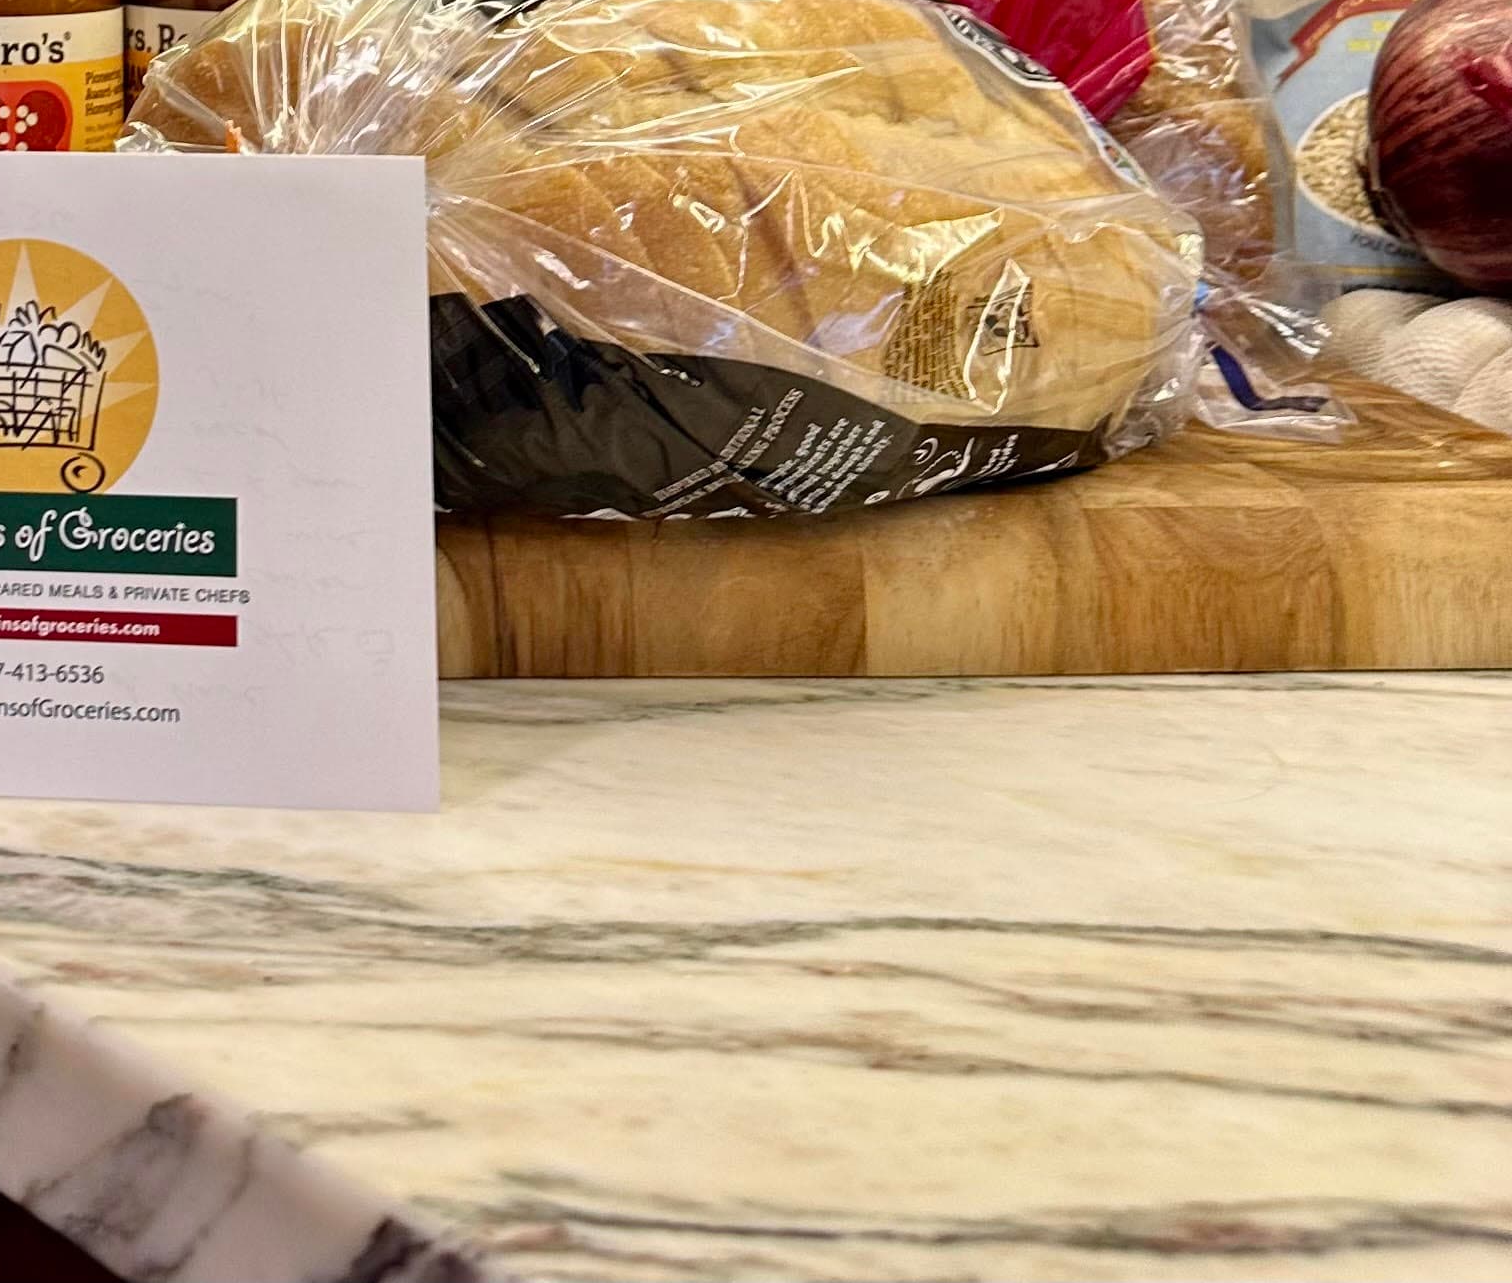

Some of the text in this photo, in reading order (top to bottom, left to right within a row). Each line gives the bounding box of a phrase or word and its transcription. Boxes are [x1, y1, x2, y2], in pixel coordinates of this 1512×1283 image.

[14, 508, 58, 561] of
[58, 507, 216, 555] Groceries
[48, 583, 104, 600] MEALS
[108, 584, 119, 600] &
[123, 585, 190, 602] PRIVATE
[194, 587, 251, 604] CHEFS
